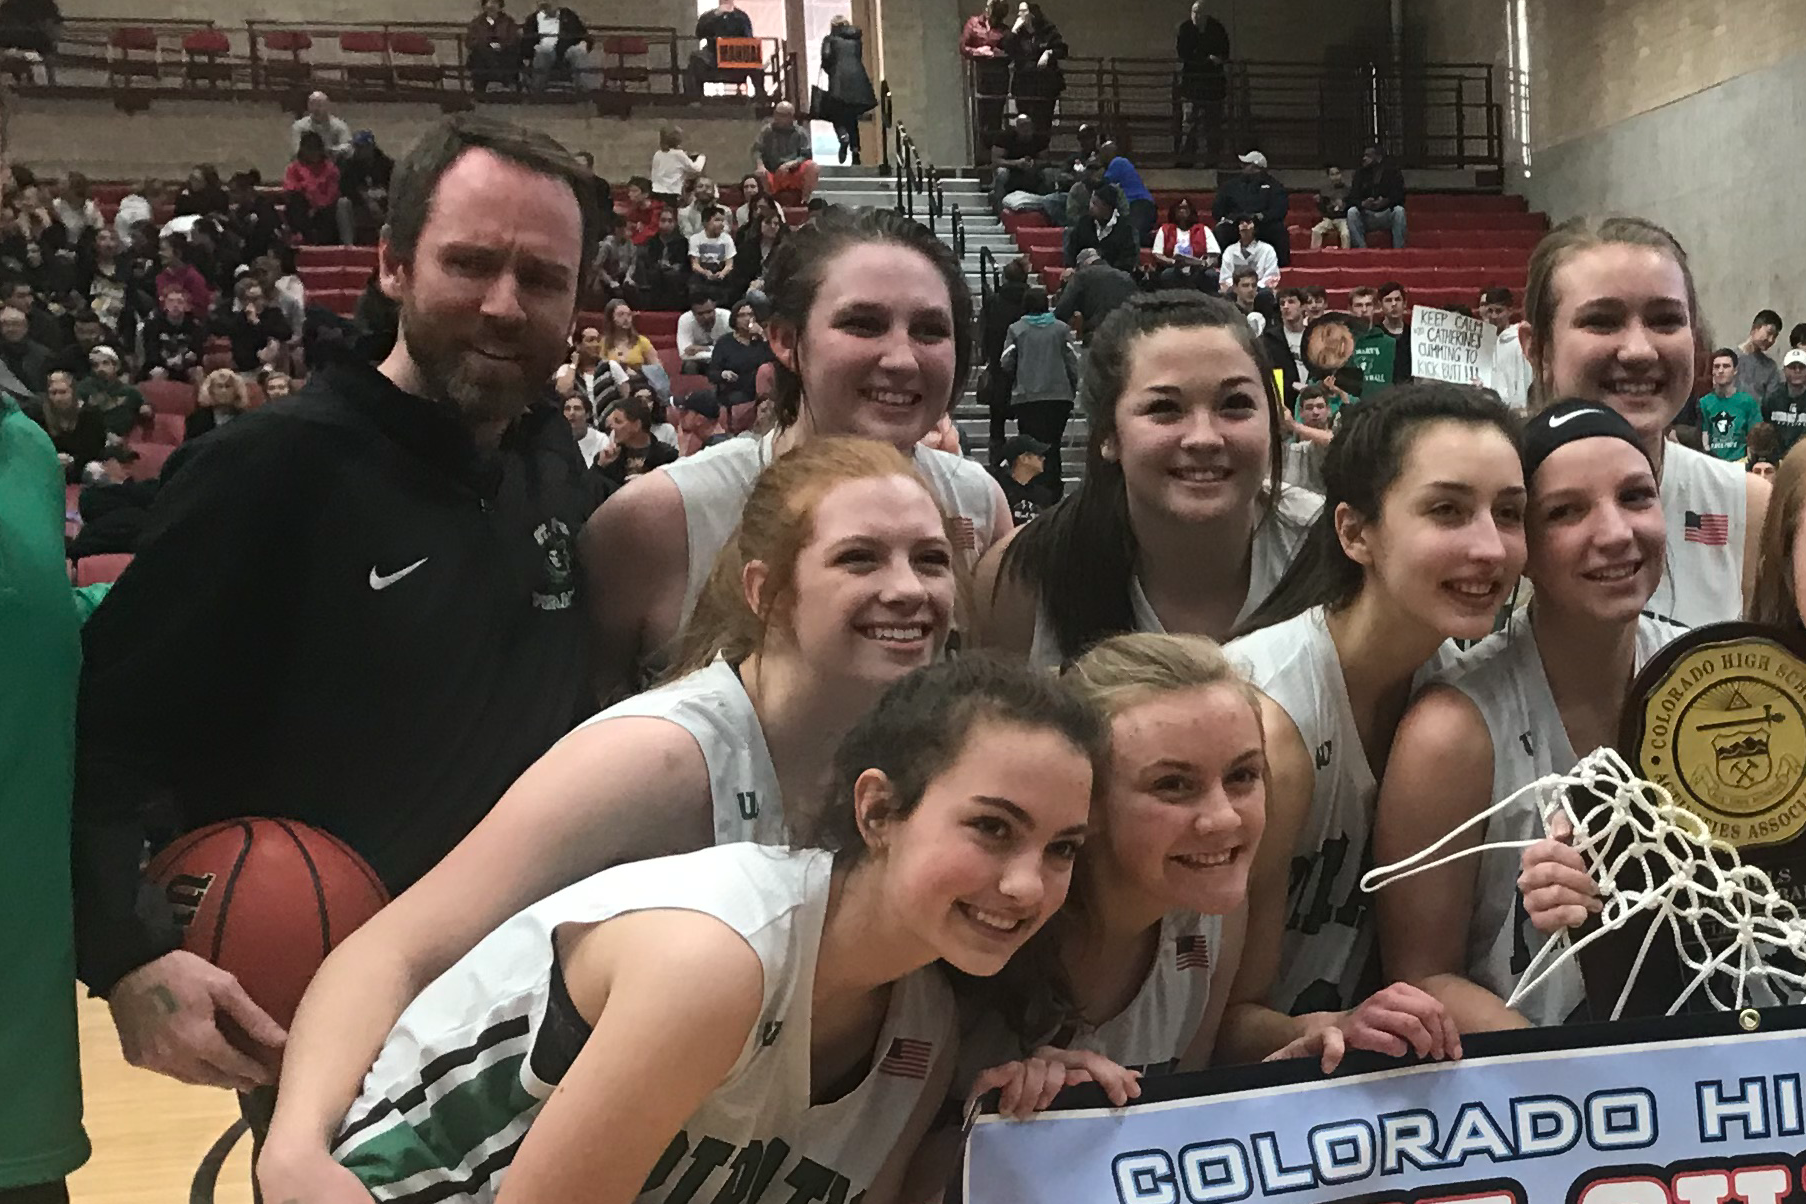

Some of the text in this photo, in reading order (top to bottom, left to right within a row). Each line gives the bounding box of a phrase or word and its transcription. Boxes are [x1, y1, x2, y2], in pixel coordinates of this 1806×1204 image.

[1420, 309, 1483, 338] KEEP CALM
[1417, 342, 1478, 364] CUMMING TO
[1417, 359, 1440, 376] KICK
[1650, 658, 1716, 750] COLORADO
[1720, 652, 1771, 673] HIGH
